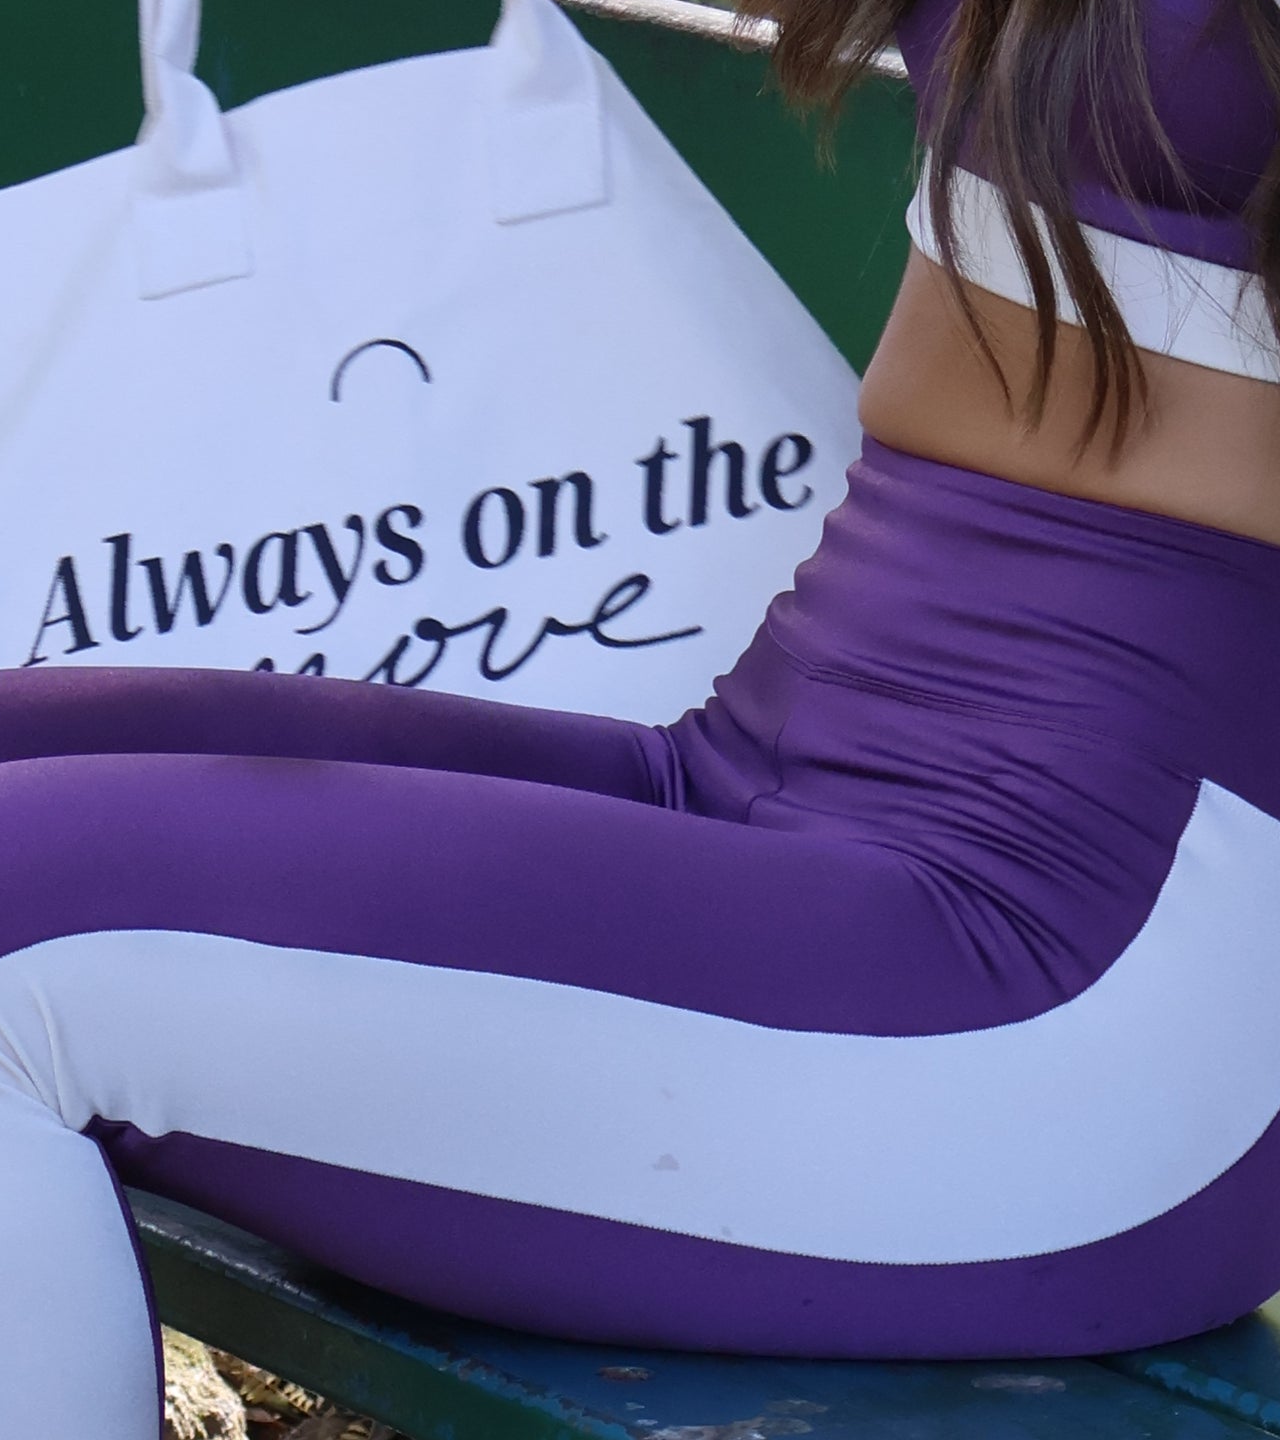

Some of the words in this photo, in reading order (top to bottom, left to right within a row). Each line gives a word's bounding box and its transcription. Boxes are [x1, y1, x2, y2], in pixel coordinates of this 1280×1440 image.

[22, 503, 425, 668] Always
[462, 470, 609, 570] on
[634, 414, 814, 537] the
[250, 572, 704, 688] ove
